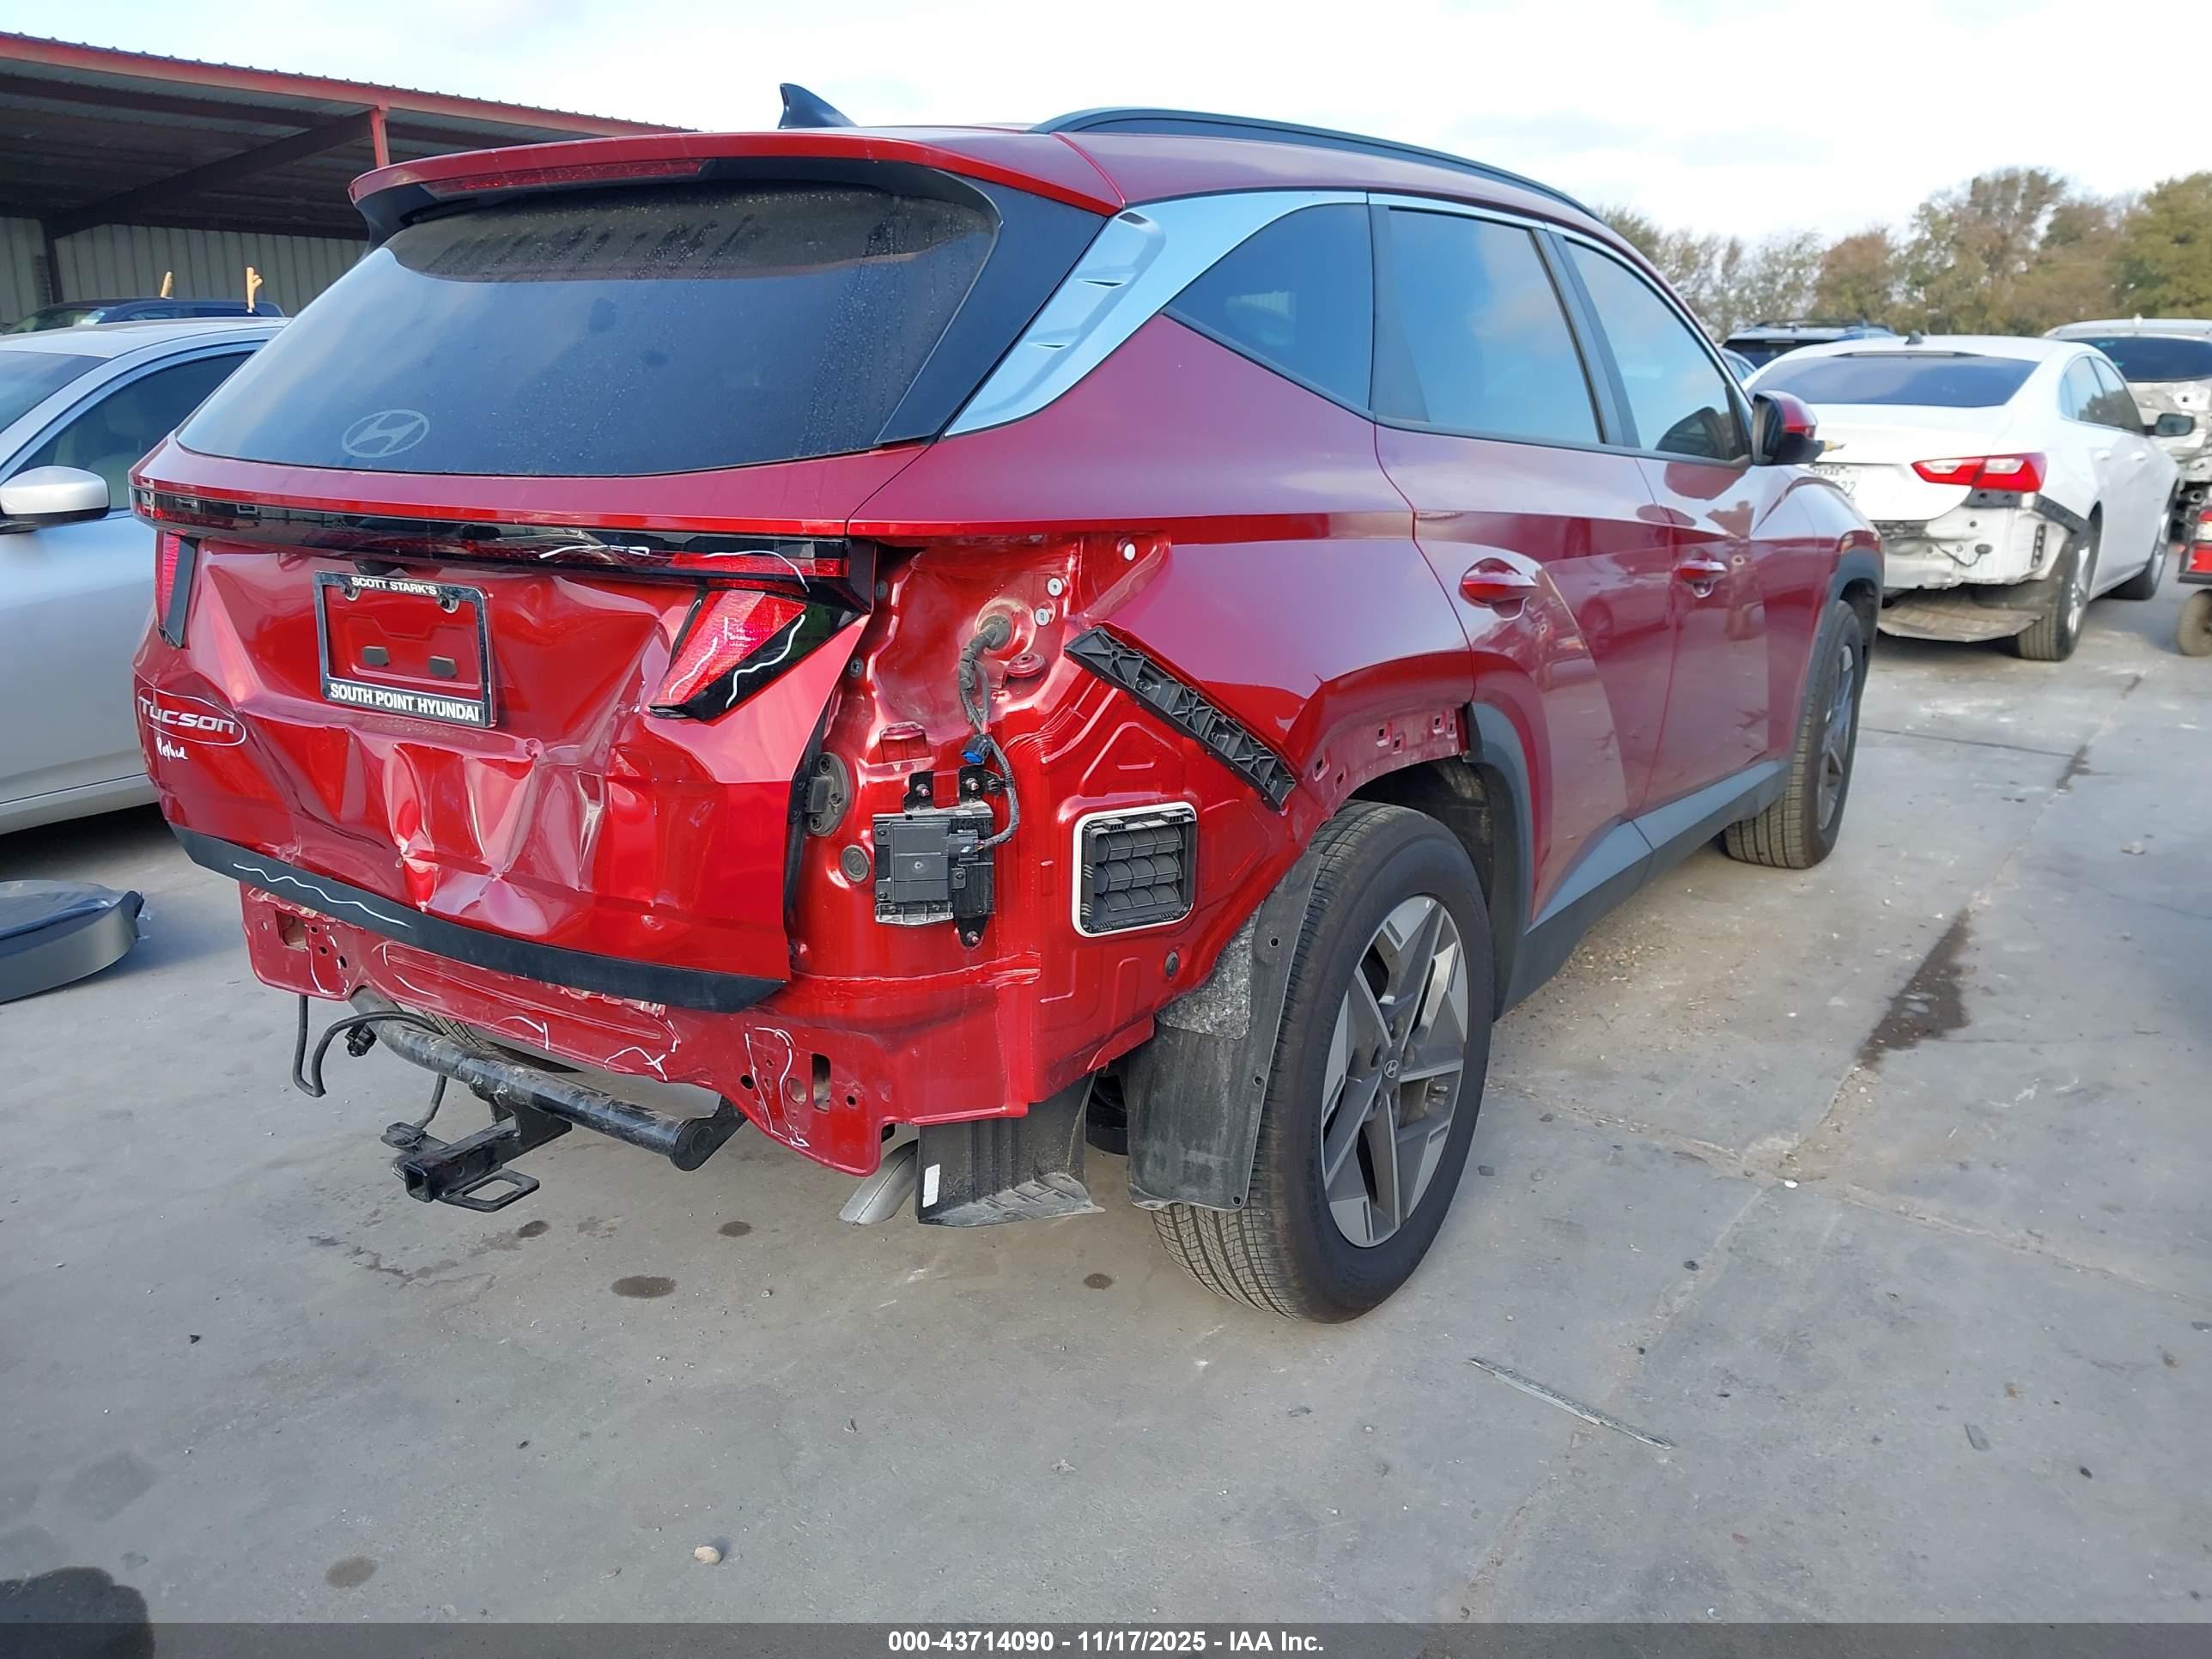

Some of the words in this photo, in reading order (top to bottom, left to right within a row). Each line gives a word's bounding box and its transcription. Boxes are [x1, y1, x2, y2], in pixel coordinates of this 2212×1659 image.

[351, 576, 386, 590] SCOTT
[390, 580, 437, 595] STARK'S
[330, 683, 373, 703] SOUTH
[375, 690, 414, 712] POINT
[418, 699, 479, 722] HYUNDAI
